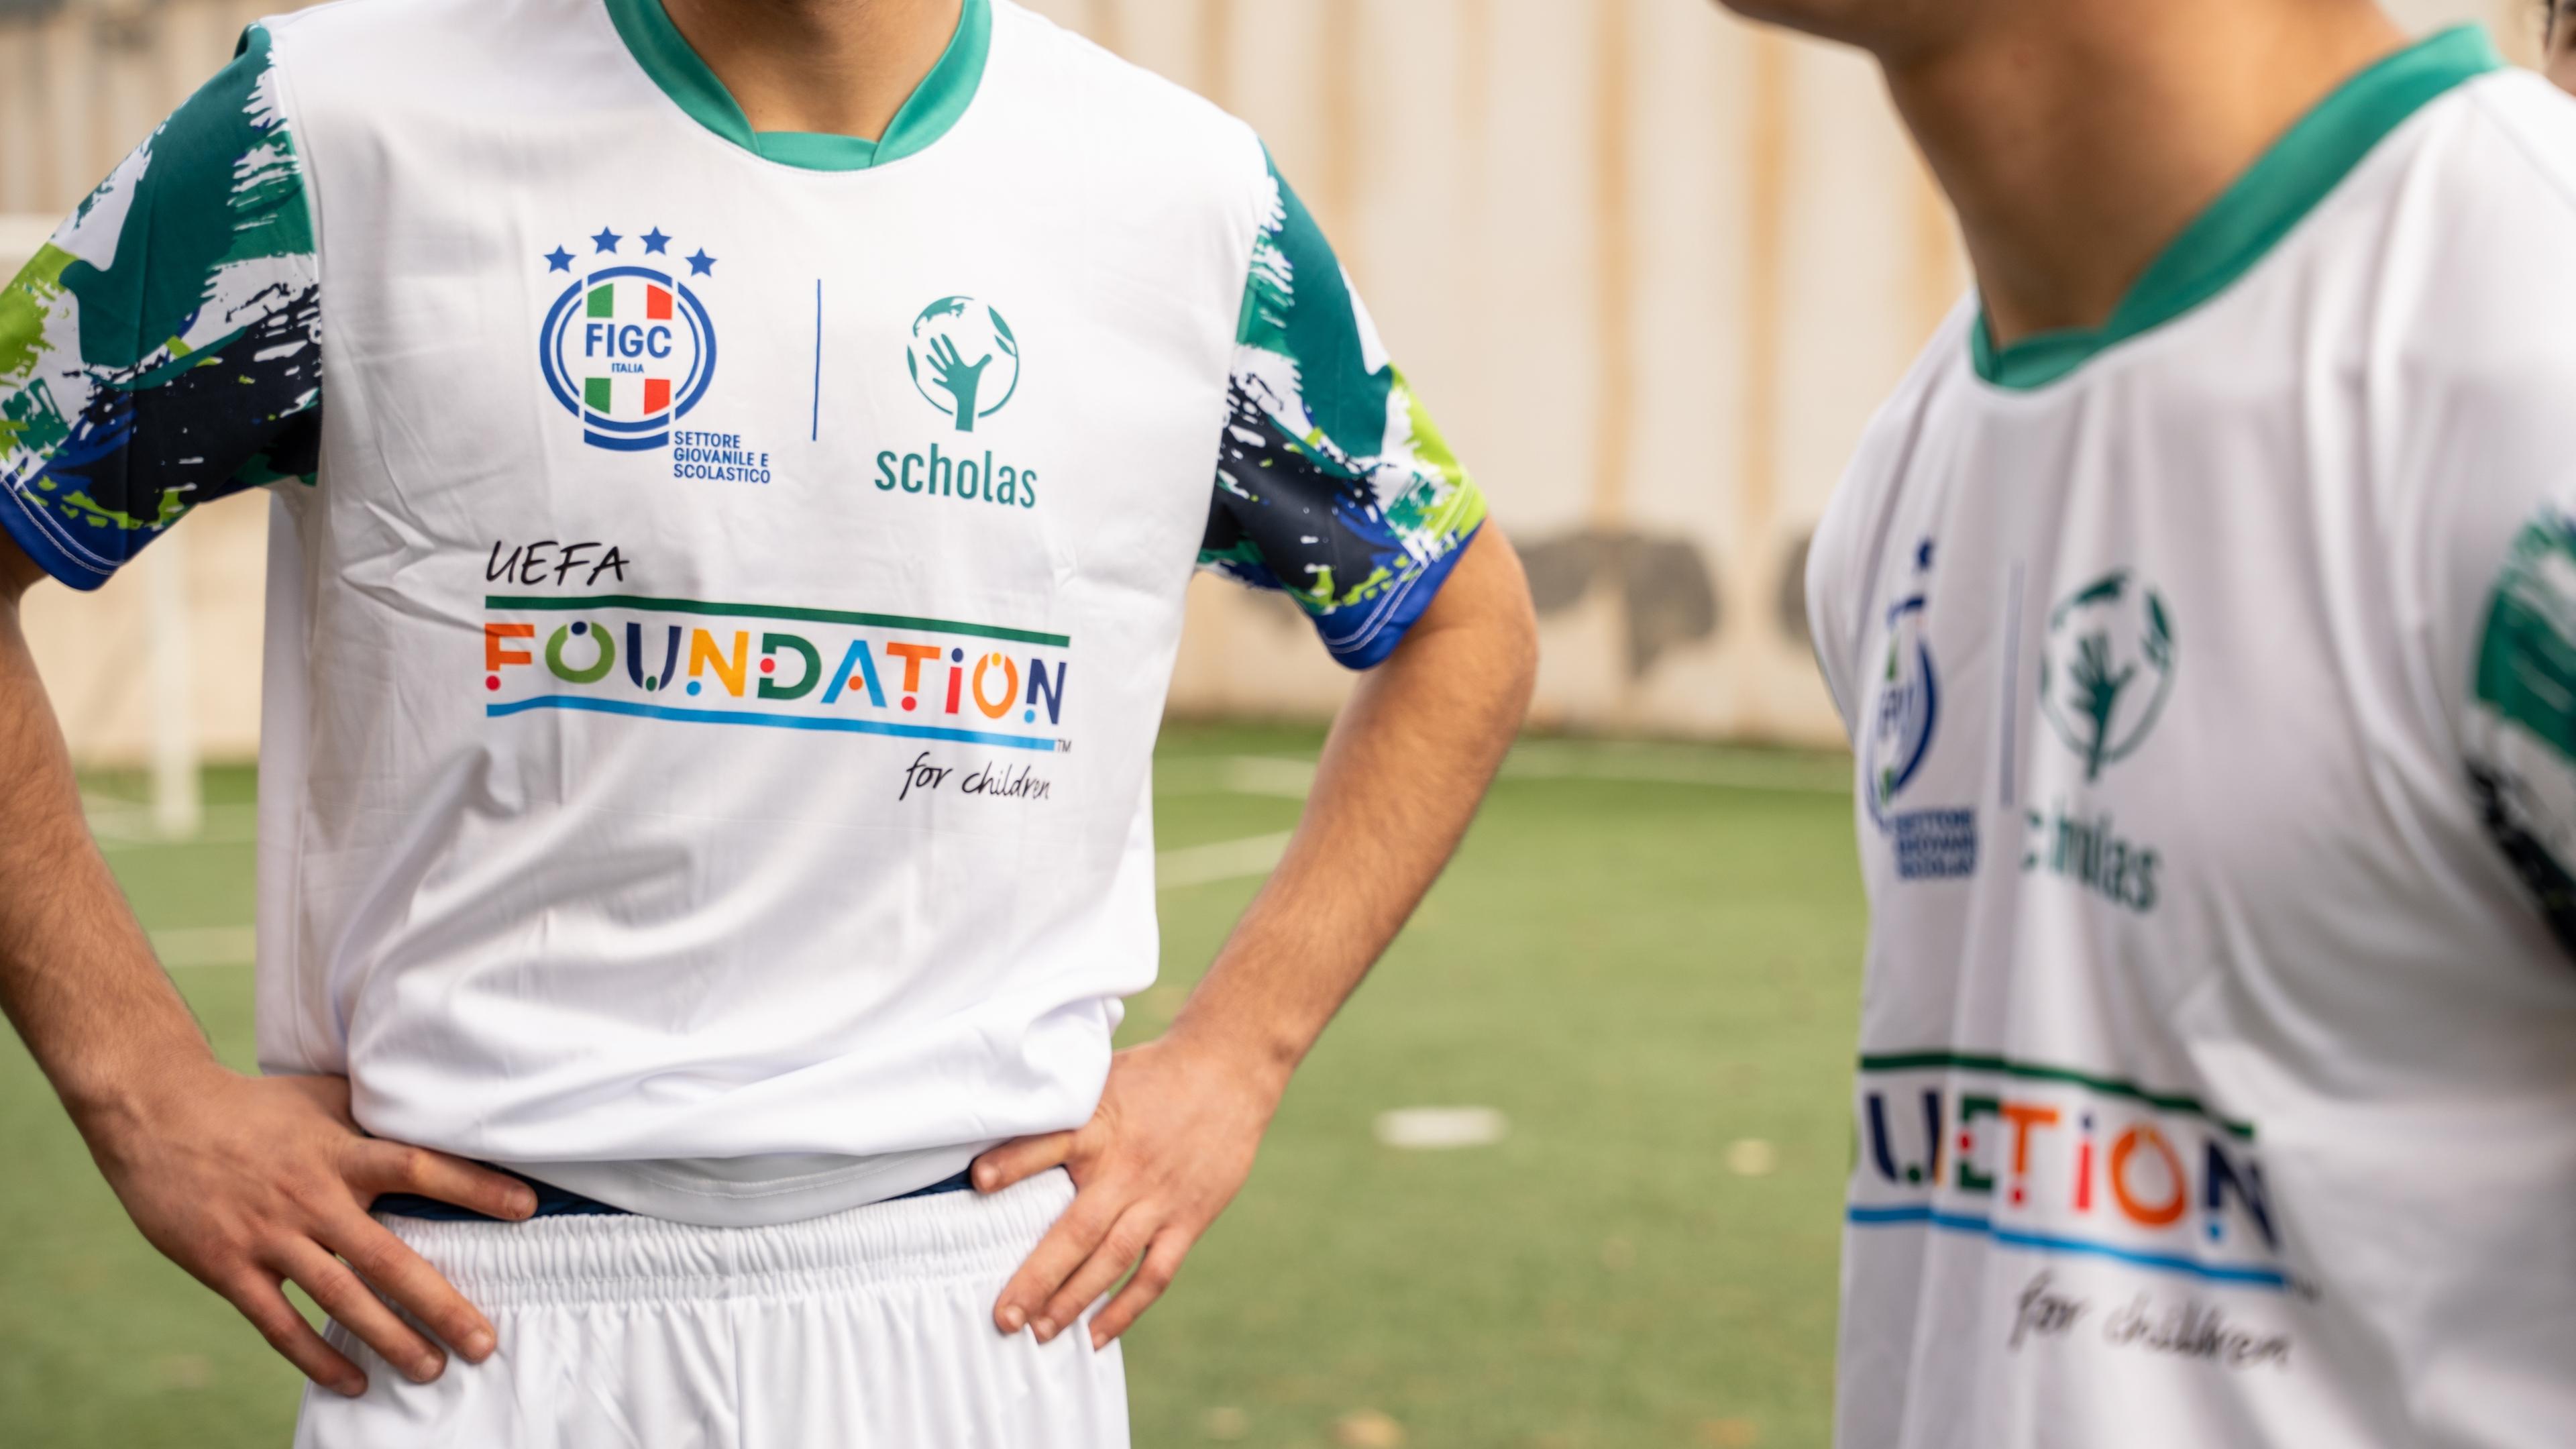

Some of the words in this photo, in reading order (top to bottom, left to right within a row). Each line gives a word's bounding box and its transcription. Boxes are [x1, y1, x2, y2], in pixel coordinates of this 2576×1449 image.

[585, 323, 672, 359] FIGC
[611, 362, 645, 374] ITALIA
[674, 431, 741, 449] SETTORE
[674, 447, 754, 466] GIOVANILE
[761, 453, 769, 467] E
[674, 464, 771, 484] SCOLASTICO
[874, 443, 1037, 508] scholas
[486, 539, 631, 587] UEFA
[898, 751, 953, 801] for
[961, 759, 1051, 800] children
